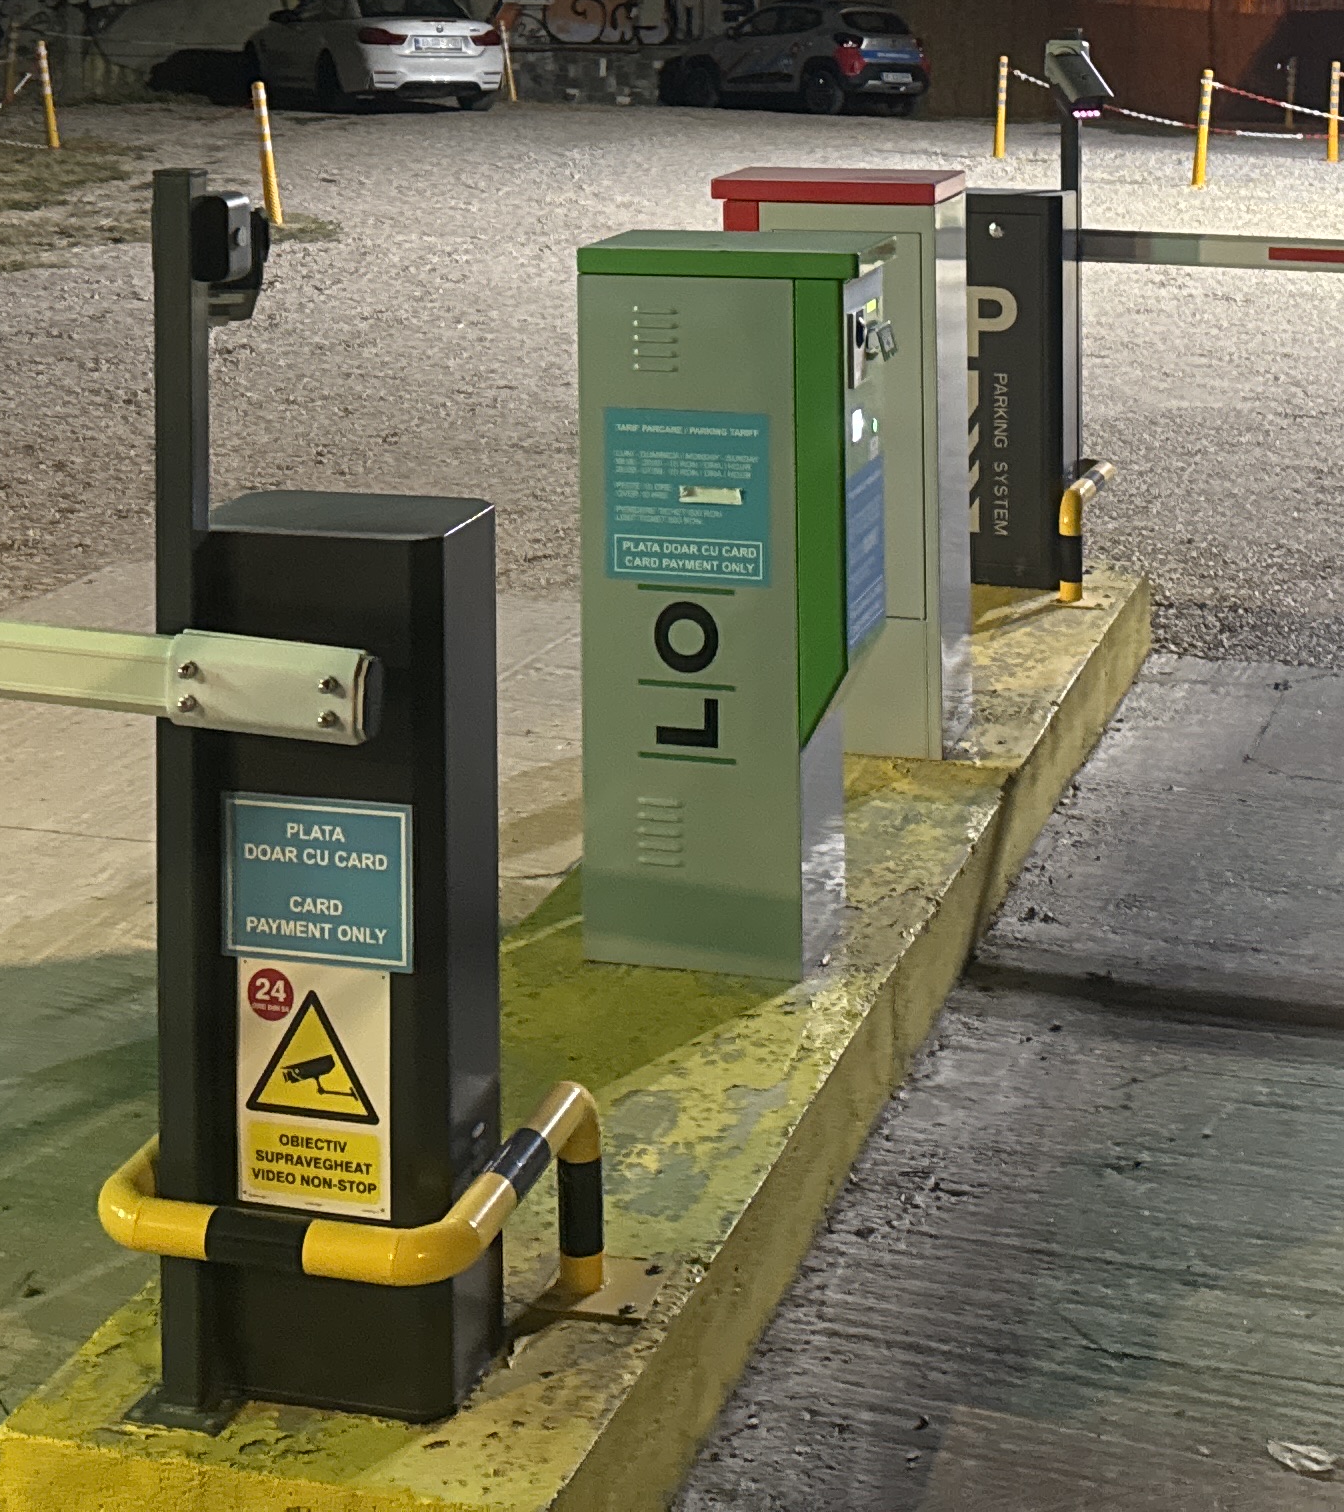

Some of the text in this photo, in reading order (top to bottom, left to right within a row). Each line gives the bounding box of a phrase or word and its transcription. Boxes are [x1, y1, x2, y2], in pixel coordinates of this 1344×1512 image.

[993, 373, 1011, 537] PARKING SYSTEM
[622, 541, 758, 559] PLATA DOAR CU CARD
[625, 556, 755, 574] CARD PAYMENT ONLY
[286, 822, 346, 843] PLATA
[244, 843, 388, 871] DOAR CU CARD
[289, 896, 343, 916] CARD
[245, 916, 388, 945] PAYMENT ONLY
[255, 977, 287, 1003] 24
[279, 1134, 347, 1153] OBIECTIV
[255, 1149, 373, 1176] SUPRAVEGHEAT
[251, 1167, 378, 1195] VIDEO NON-STOP
